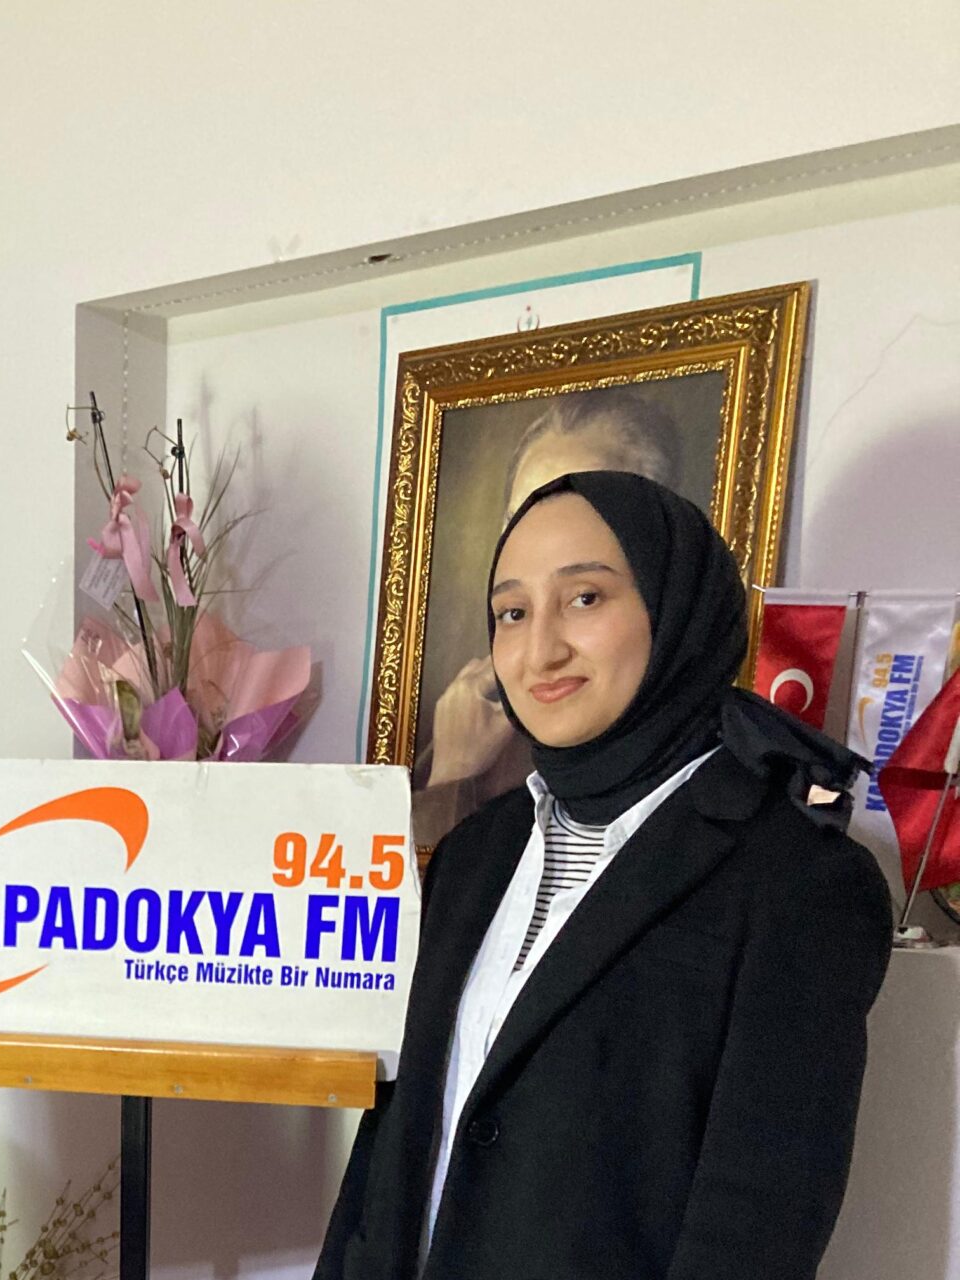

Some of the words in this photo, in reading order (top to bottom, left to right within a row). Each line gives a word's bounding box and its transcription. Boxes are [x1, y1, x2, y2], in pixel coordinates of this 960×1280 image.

[872, 653, 892, 688] 94.5
[889, 654, 915, 684] FM
[272, 831, 406, 891] 94.5
[305, 894, 401, 963] FM
[124, 959, 189, 984] Türkçe
[196, 962, 273, 987] Müzikte
[281, 966, 309, 987] Bir
[316, 968, 395, 991] Numara
